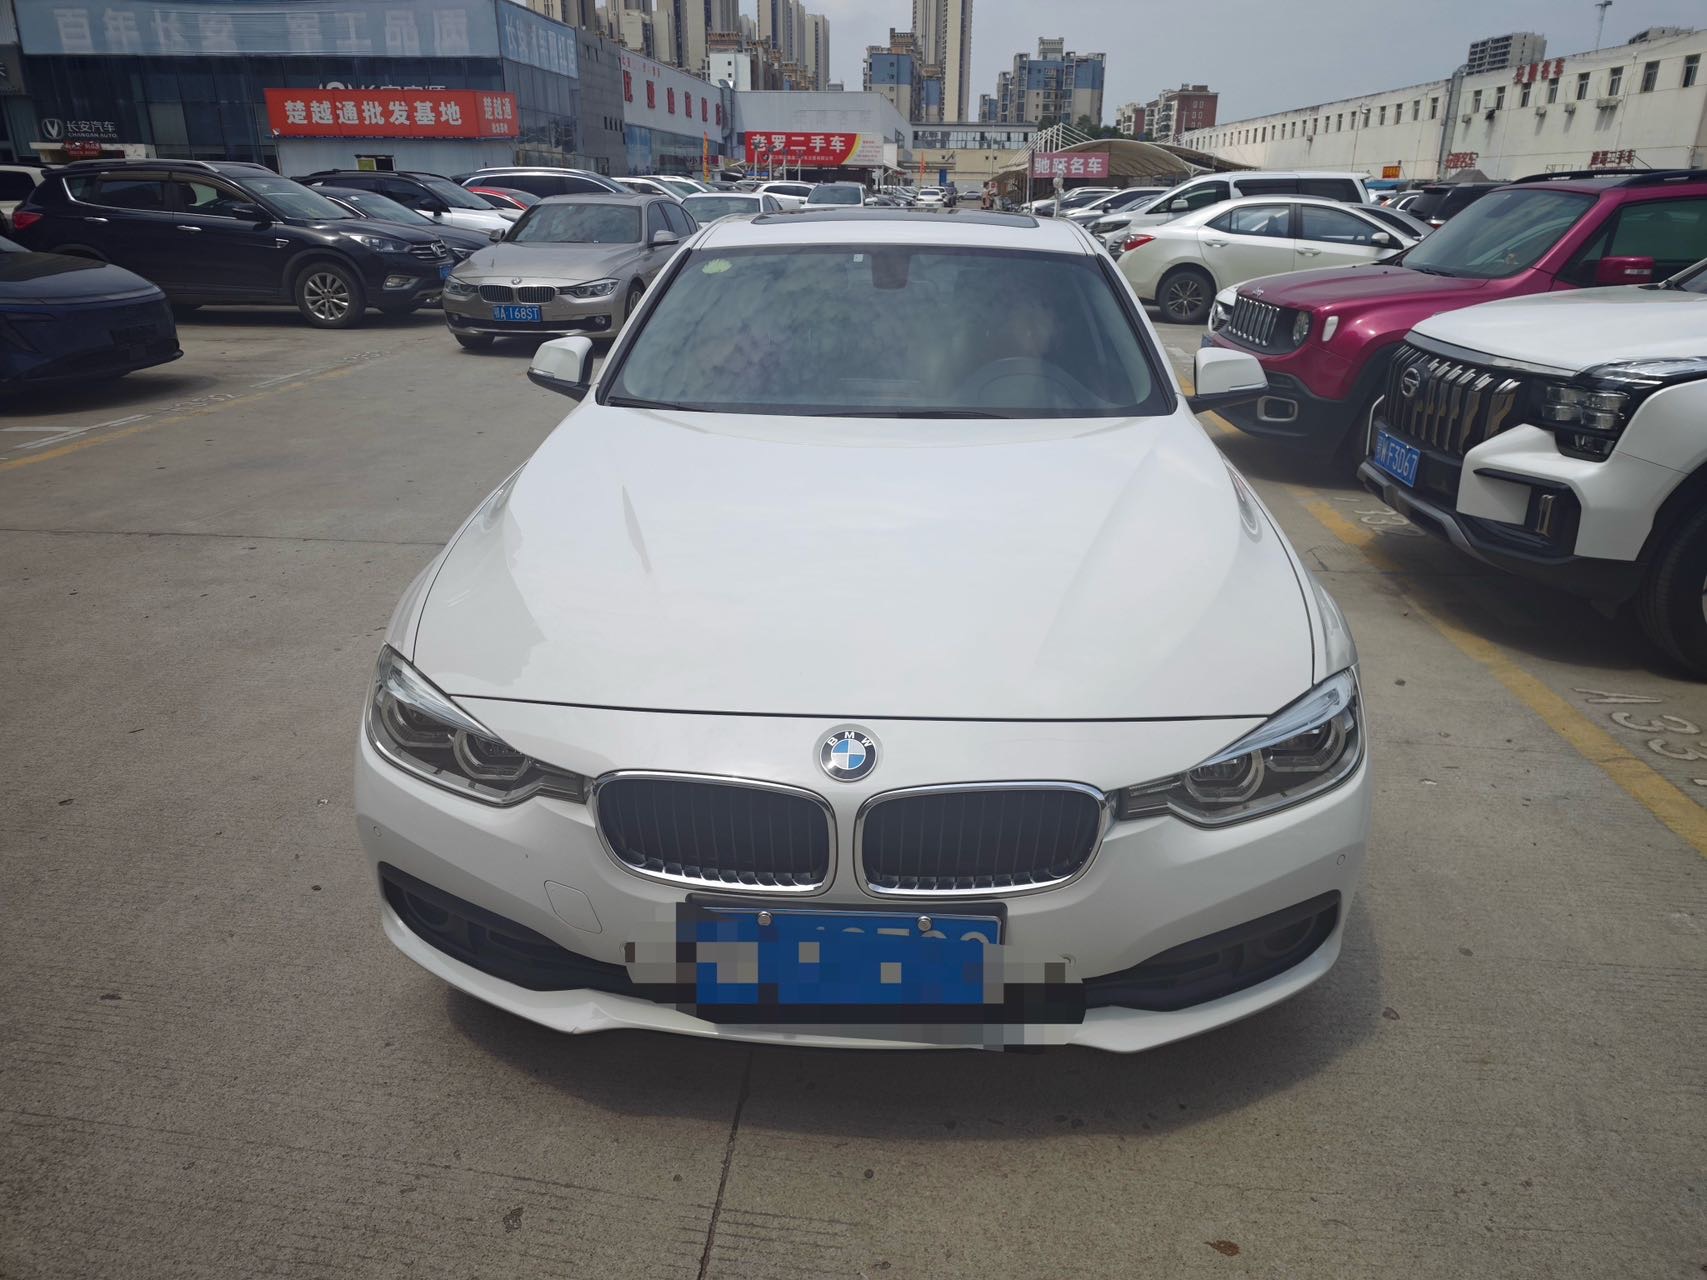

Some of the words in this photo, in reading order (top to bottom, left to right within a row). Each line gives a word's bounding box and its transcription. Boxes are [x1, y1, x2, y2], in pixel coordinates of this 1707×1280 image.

[285, 100, 462, 125] 楚越通批发基地
[66, 120, 116, 132] 长安汽车
[751, 134, 846, 153] 老罗二手车
[827, 731, 873, 747] BMW
